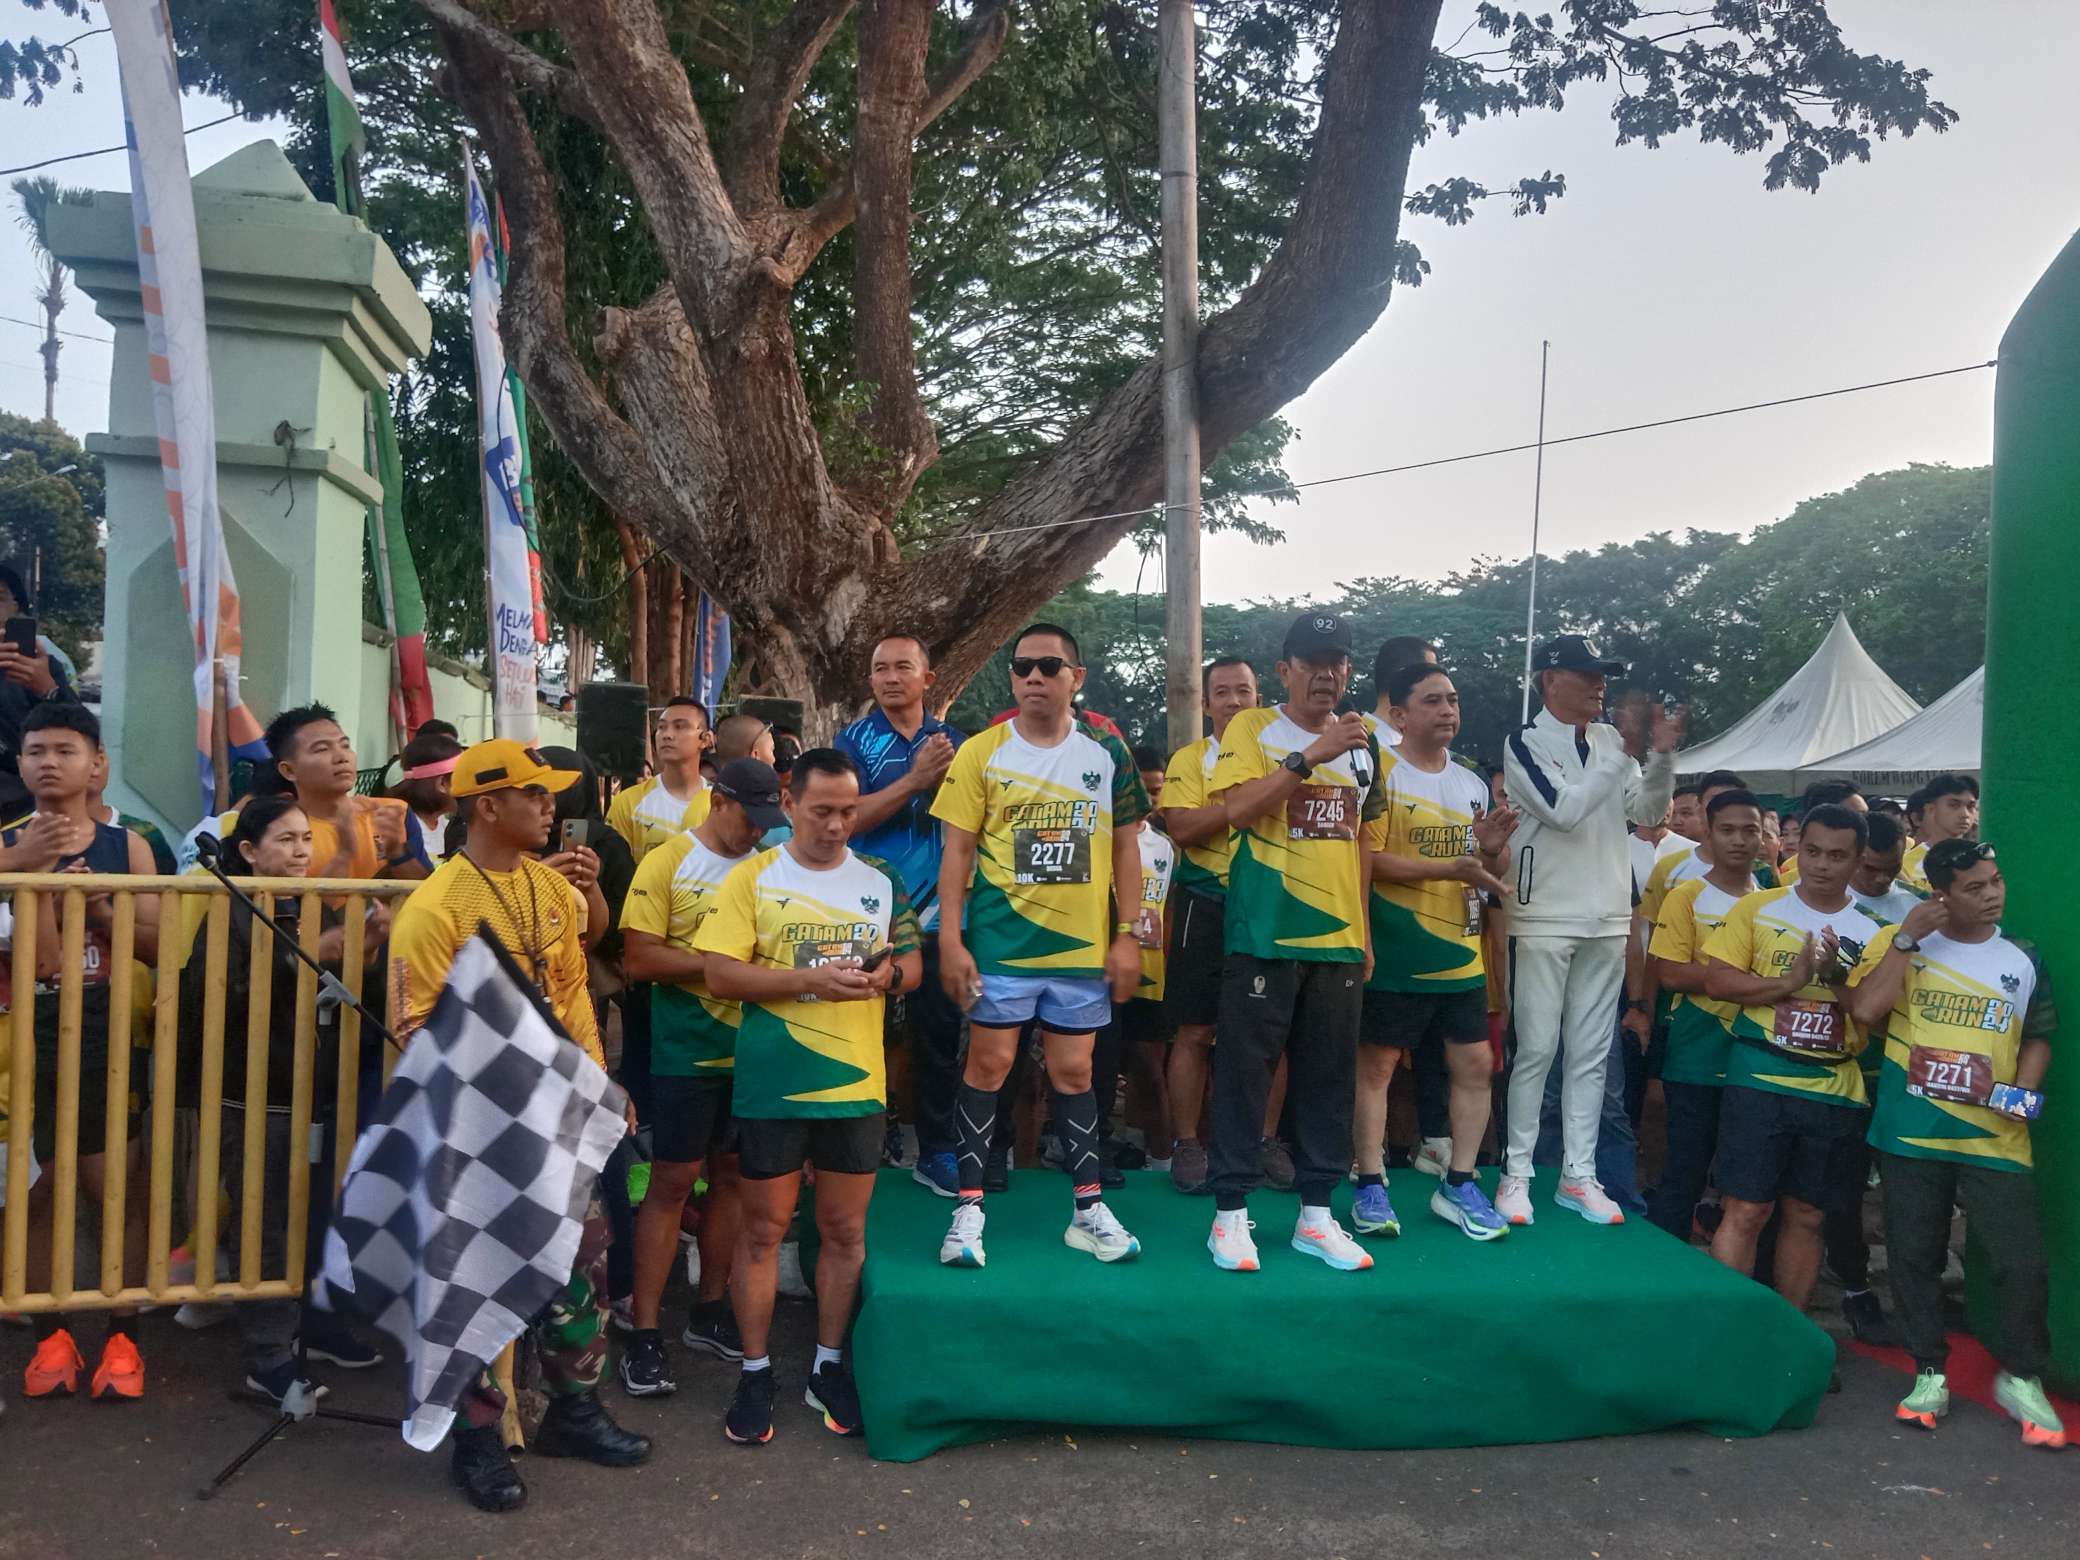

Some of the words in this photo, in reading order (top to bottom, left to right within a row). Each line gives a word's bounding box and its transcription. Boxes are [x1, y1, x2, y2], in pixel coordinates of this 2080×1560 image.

[1316, 618, 1334, 629] 92
[1305, 800, 1344, 822] 7245
[1031, 842, 1075, 866] 2277
[1431, 841, 1466, 857] RUN
[1017, 873, 1034, 884] 10K
[1791, 1011, 1834, 1035] 7272
[1935, 1006, 1983, 1029] RUN
[1776, 1034, 1788, 1046] 5K
[1925, 1060, 1972, 1087] 7271
